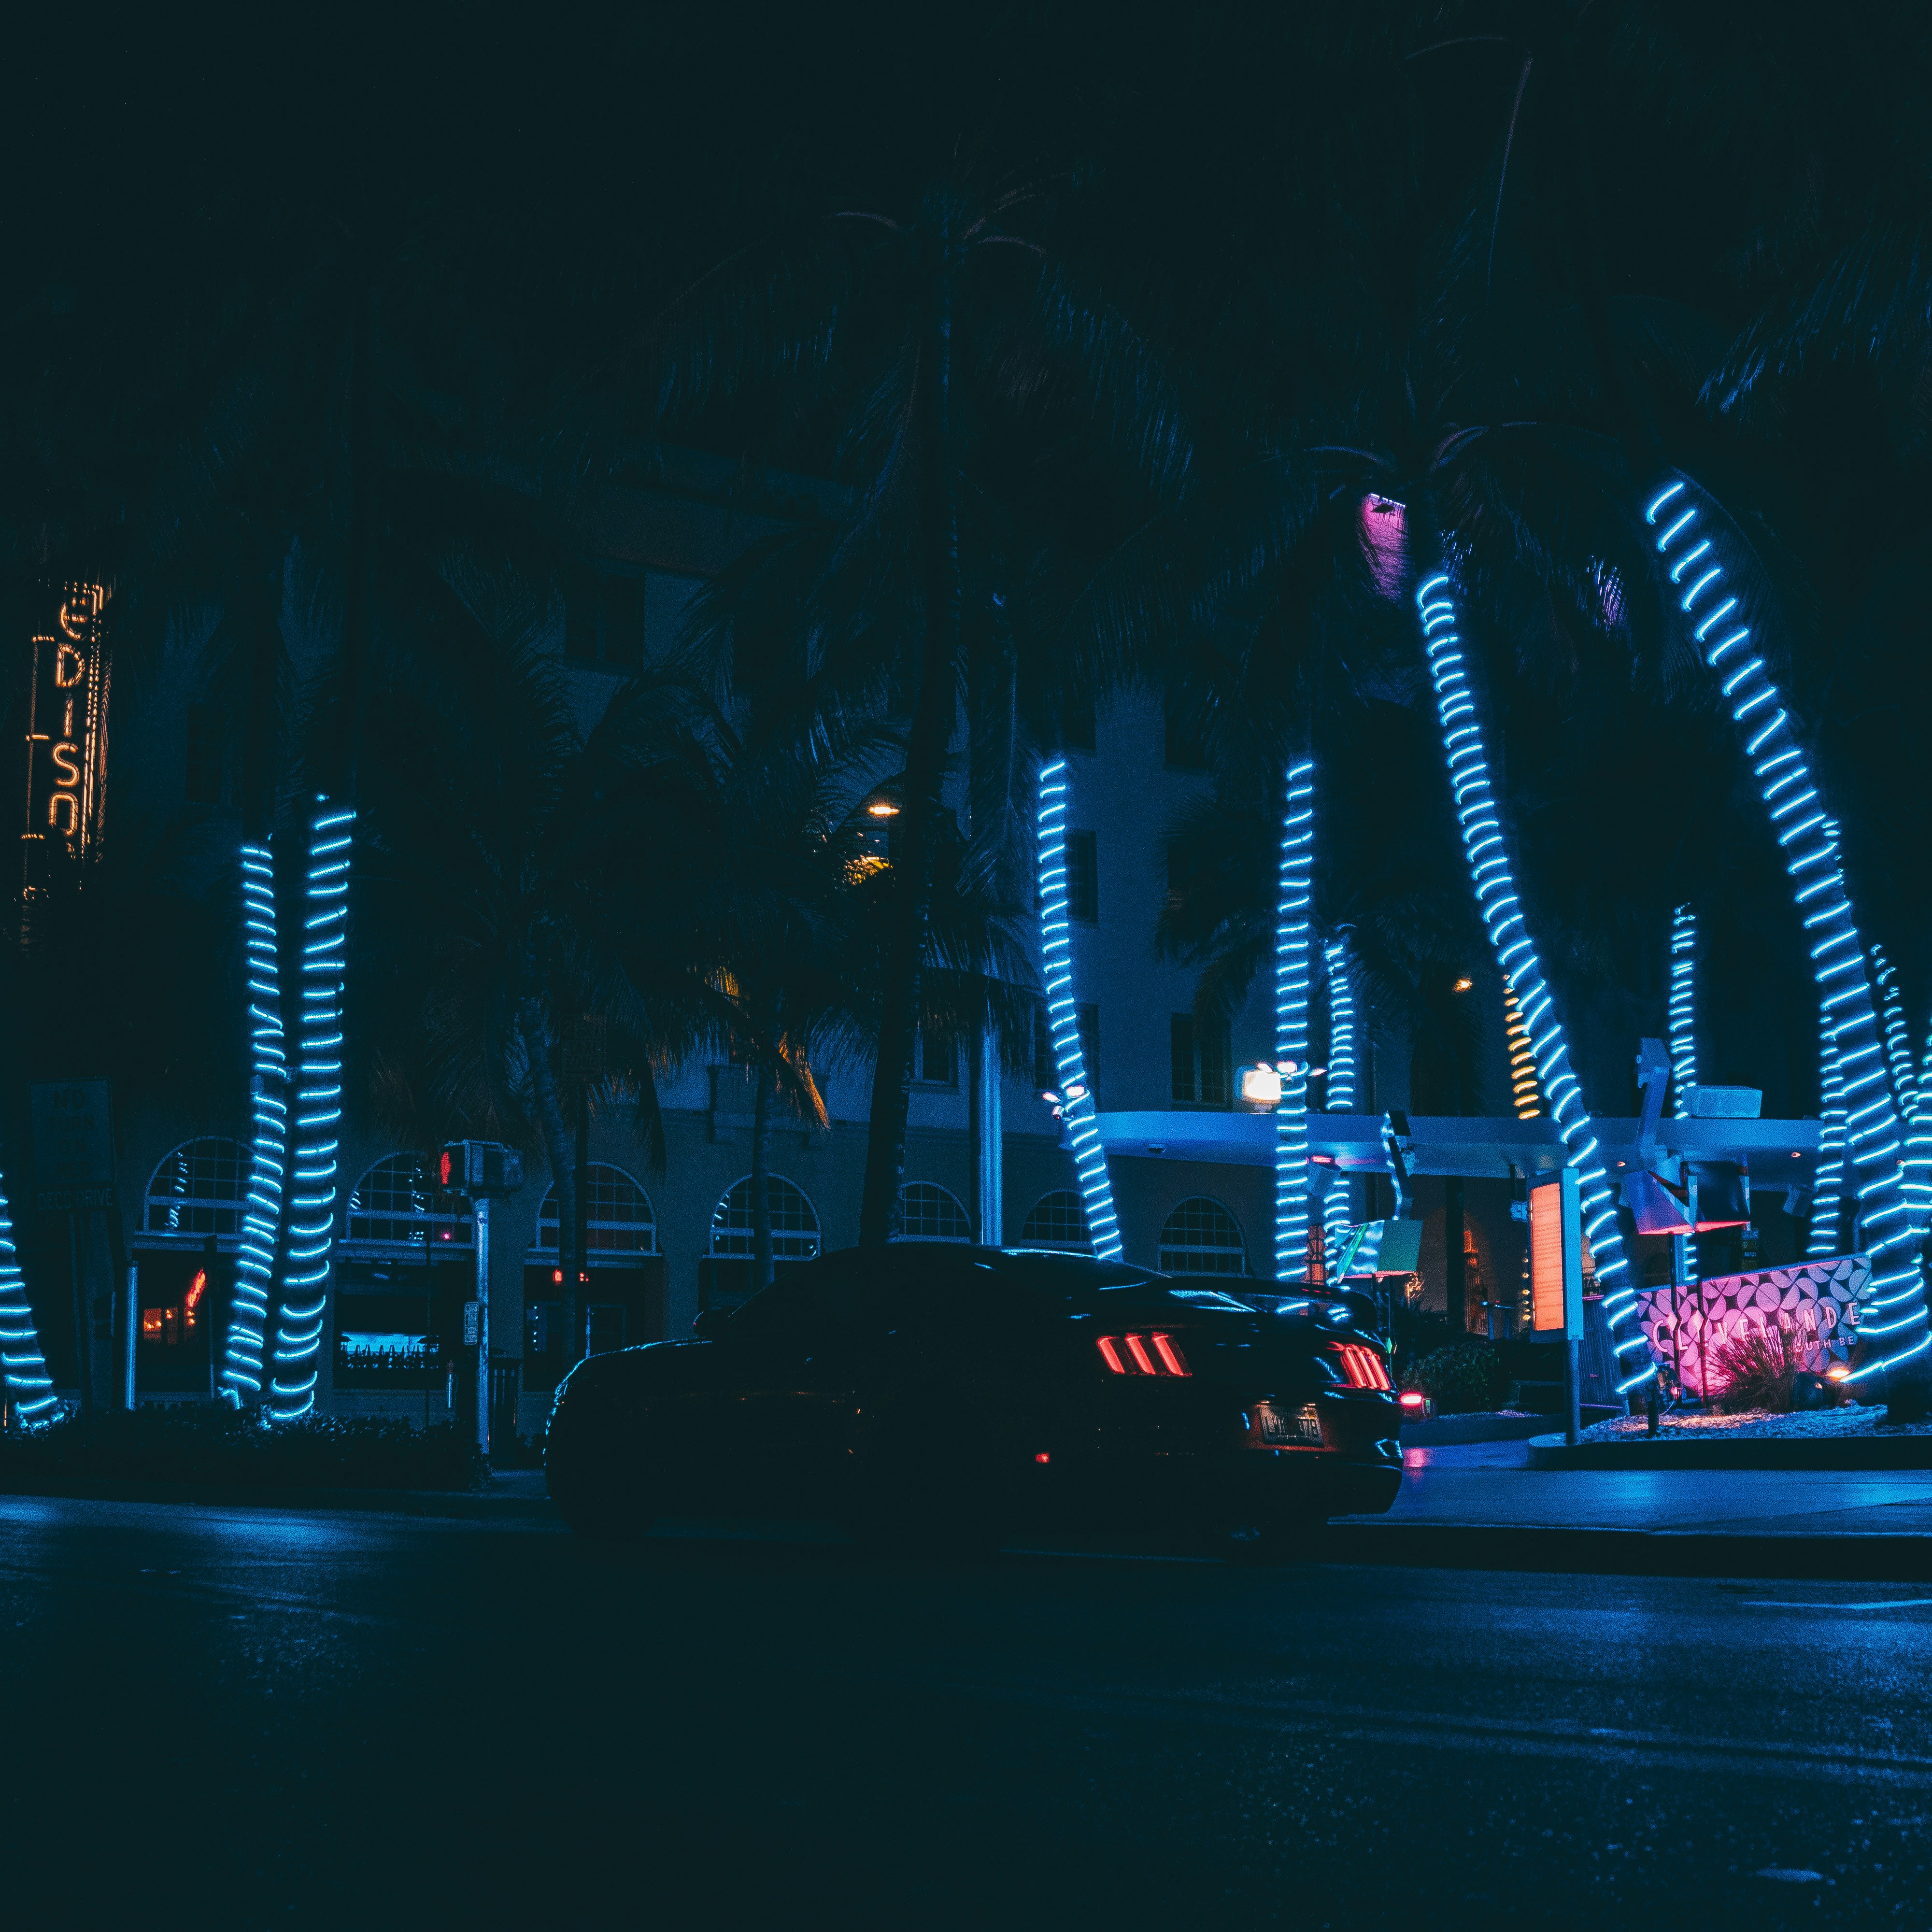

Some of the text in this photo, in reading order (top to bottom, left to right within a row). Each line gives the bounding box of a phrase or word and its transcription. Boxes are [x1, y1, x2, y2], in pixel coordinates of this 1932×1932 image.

[49, 596, 89, 859] EDISO
[54, 1088, 85, 1109] NO
[47, 1115, 95, 1132] TURN
[60, 1137, 85, 1154] ON
[1652, 1302, 1861, 1353] CLVELANDE
